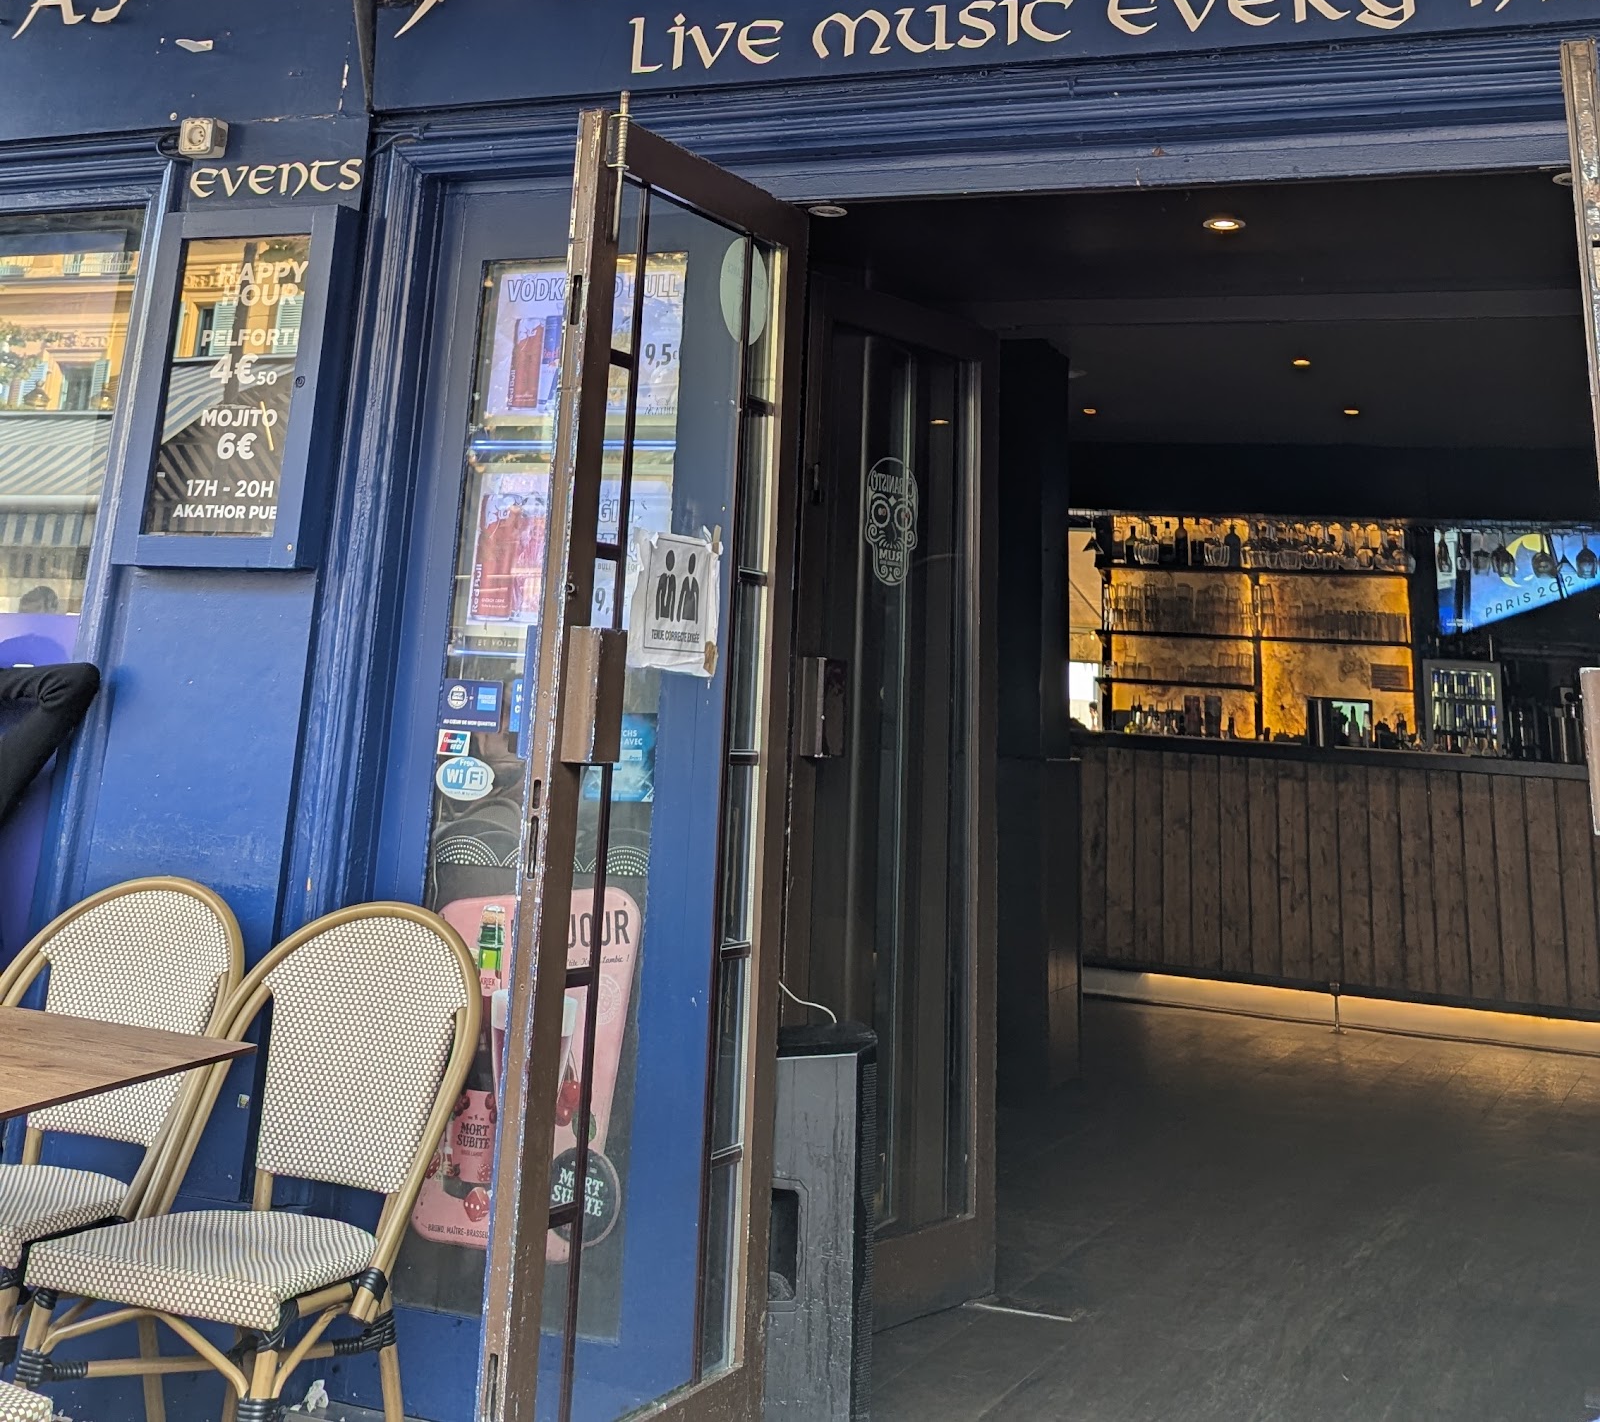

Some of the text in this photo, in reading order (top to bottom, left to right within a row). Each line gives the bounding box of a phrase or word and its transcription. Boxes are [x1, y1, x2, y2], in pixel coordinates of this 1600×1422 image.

[219, 261, 309, 284] HAPPY
[221, 284, 299, 306] HOUR
[200, 409, 278, 427] MOJITO
[217, 432, 258, 460] 6€
[186, 480, 218, 497] 17H
[234, 480, 275, 498] 20H
[173, 504, 245, 519] AKATHOR
[1485, 592, 1532, 618] PARIS
[459, 758, 476, 767] Free
[460, 1121, 490, 1136] MORT
[456, 1134, 491, 1149] SUBITE
[558, 1167, 604, 1197] MRT
